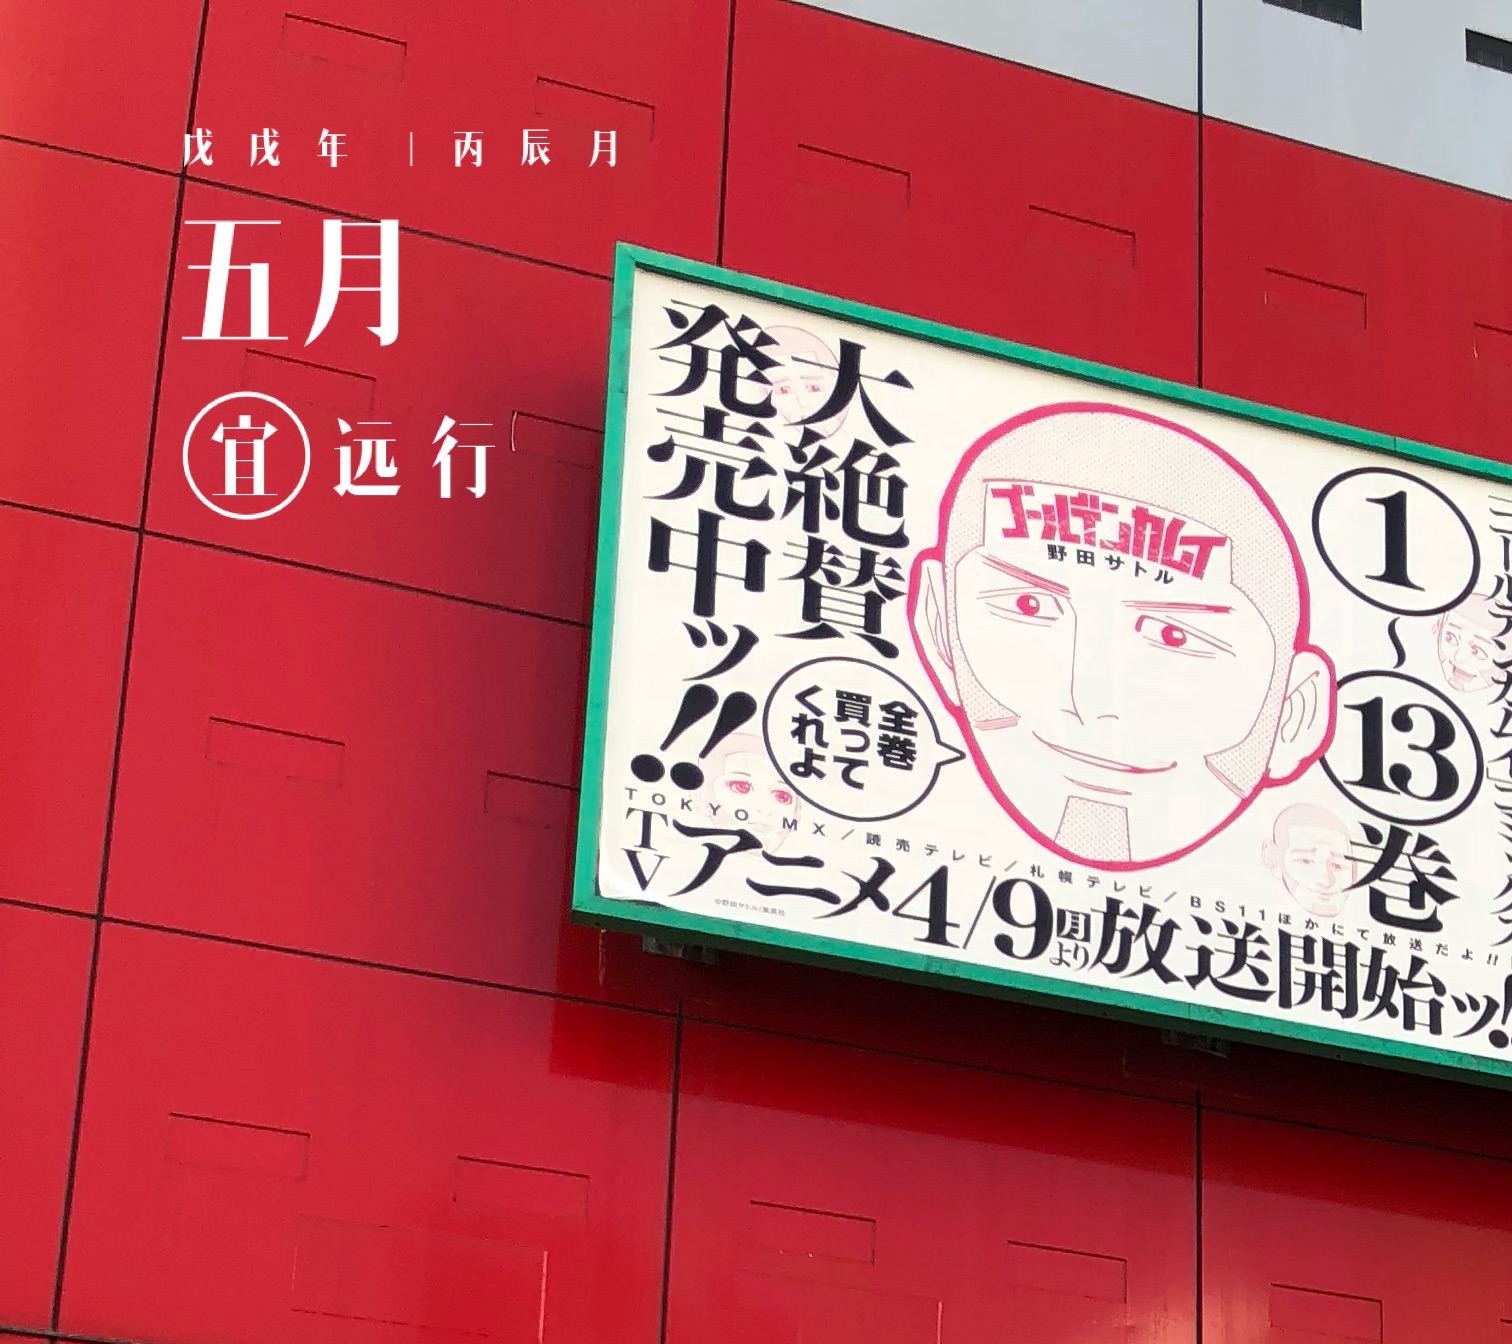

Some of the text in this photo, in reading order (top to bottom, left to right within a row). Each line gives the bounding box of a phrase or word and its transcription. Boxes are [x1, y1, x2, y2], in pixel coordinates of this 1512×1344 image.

[776, 338, 915, 659] 大絶賛
[991, 483, 1228, 581] ゴールデンカムイ
[1047, 544, 1174, 585] 野田サトル
[789, 684, 829, 780] くれよ
[833, 689, 873, 791] 買って
[876, 699, 919, 773] 全巻
[625, 786, 750, 823] TOKYO
